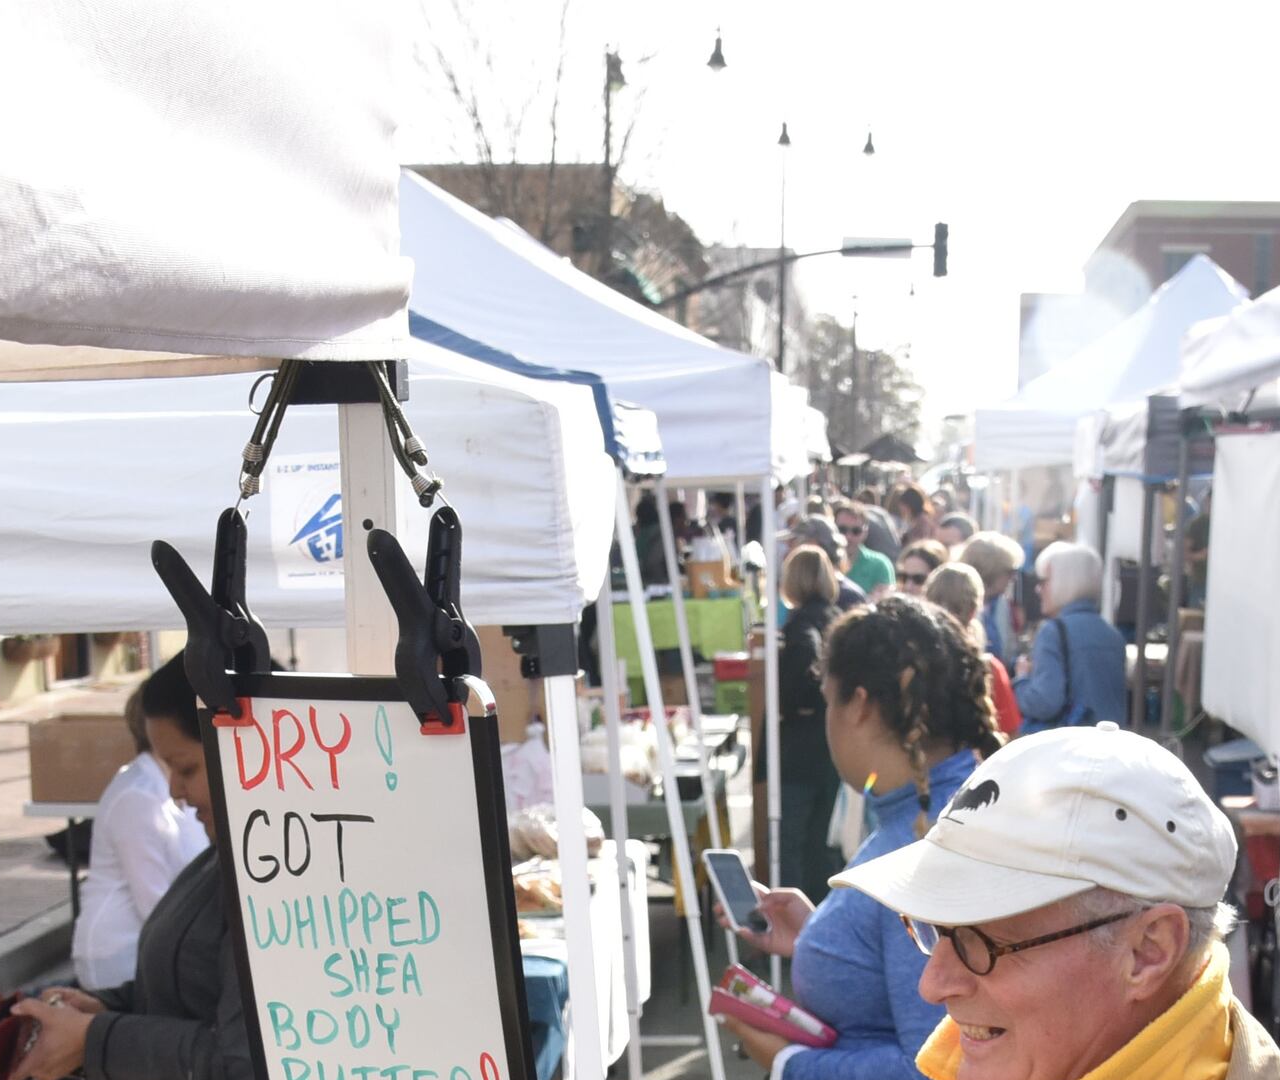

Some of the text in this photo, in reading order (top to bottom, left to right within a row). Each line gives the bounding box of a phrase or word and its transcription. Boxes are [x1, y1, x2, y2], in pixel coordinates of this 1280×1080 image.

[234, 705, 351, 791] DRY
[243, 809, 375, 883] GOT
[248, 887, 440, 949] WHIPPED
[324, 948, 423, 997] SHEA
[267, 1002, 401, 1054] BODY
